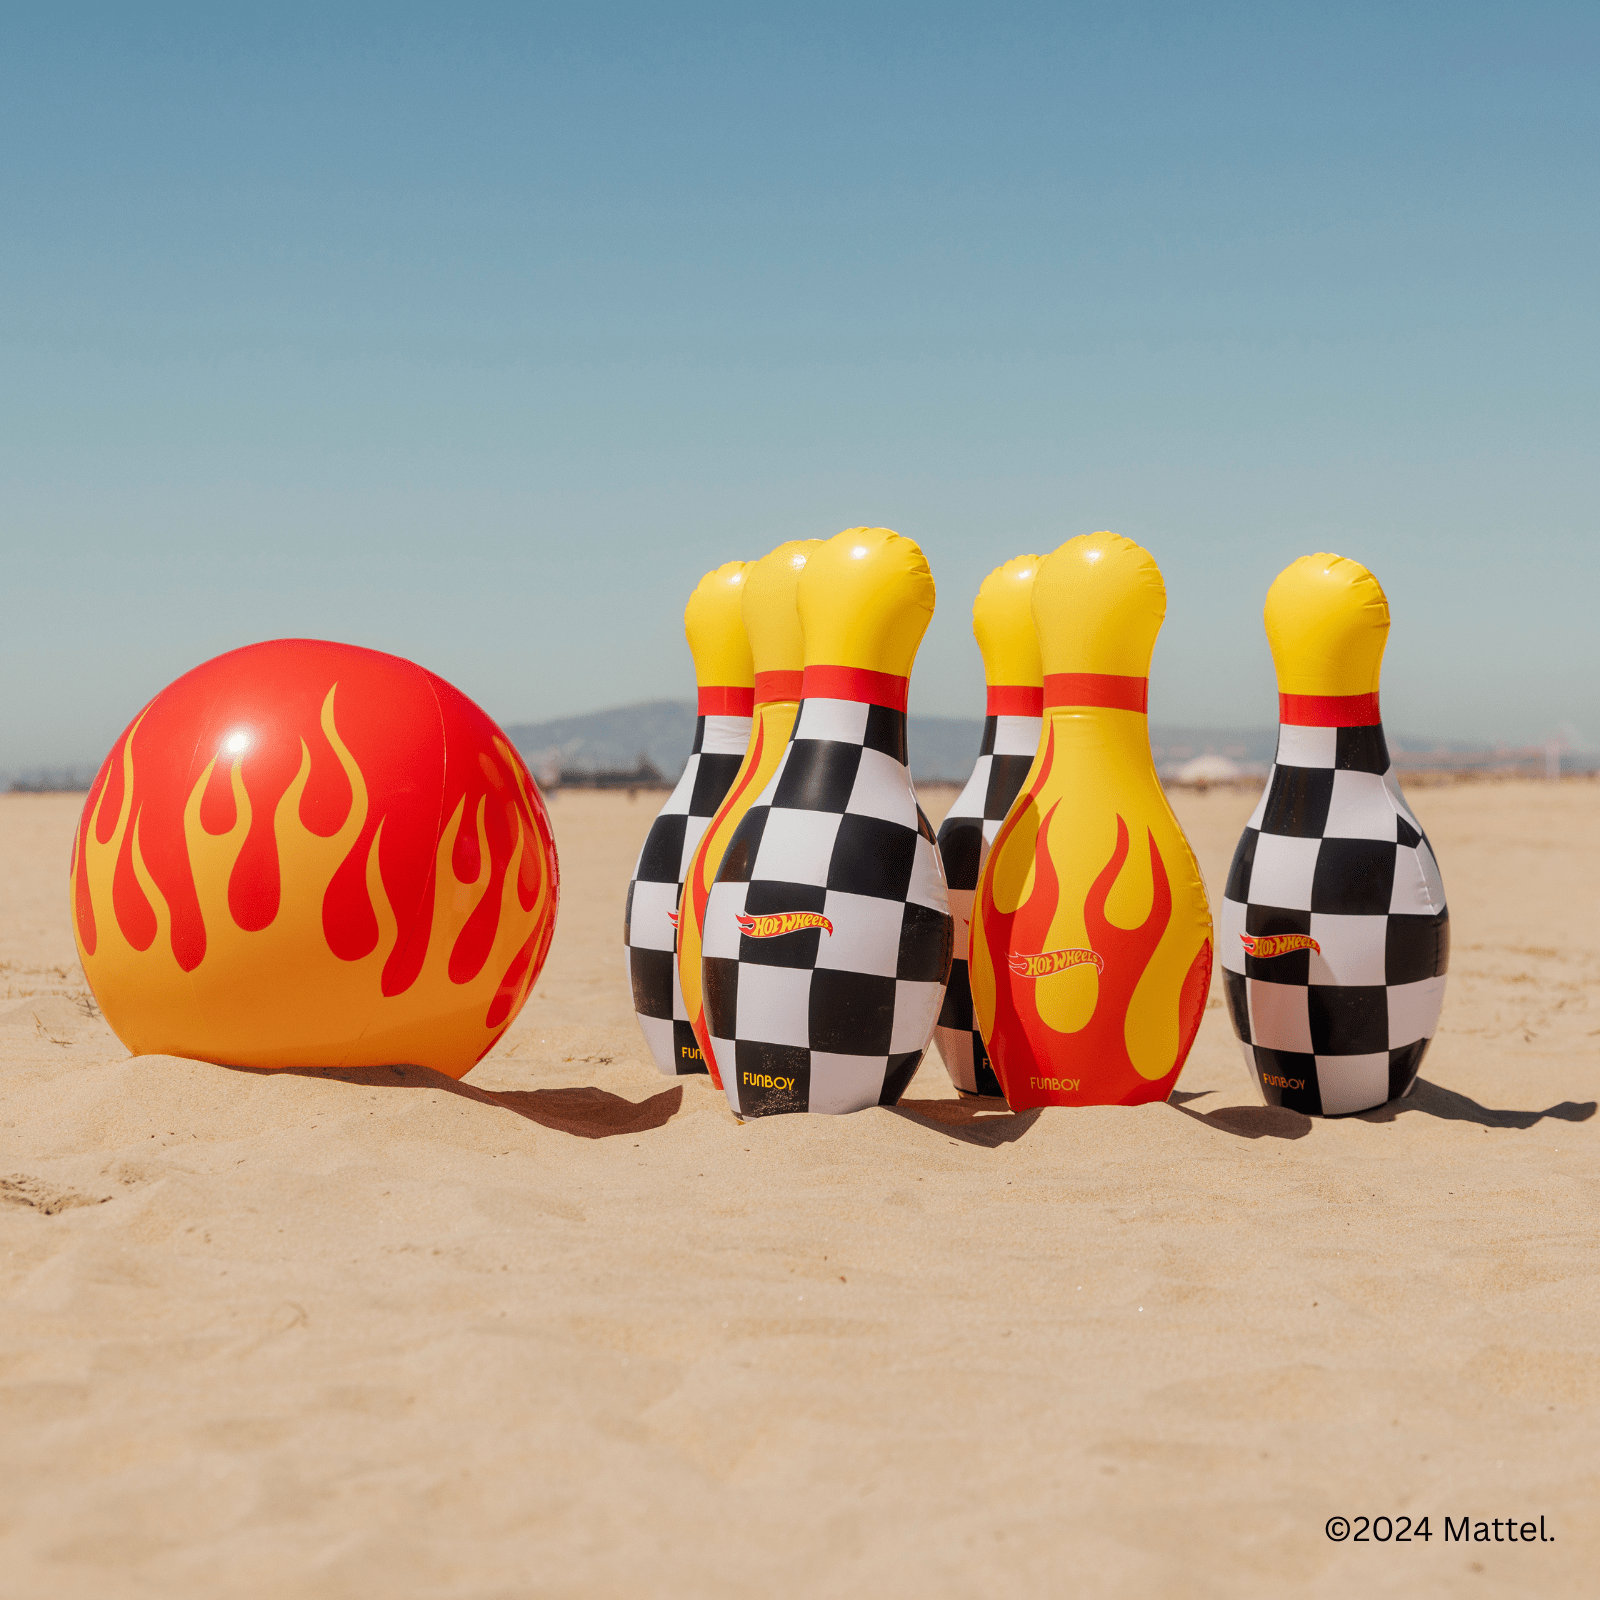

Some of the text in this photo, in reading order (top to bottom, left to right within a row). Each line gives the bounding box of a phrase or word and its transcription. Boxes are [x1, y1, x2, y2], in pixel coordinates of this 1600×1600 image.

[681, 1046, 703, 1060] FUN
[743, 1071, 795, 1091] FUNBOY
[1030, 1076, 1081, 1092] FUNBOY
[1262, 1073, 1305, 1090] FUNBOY
